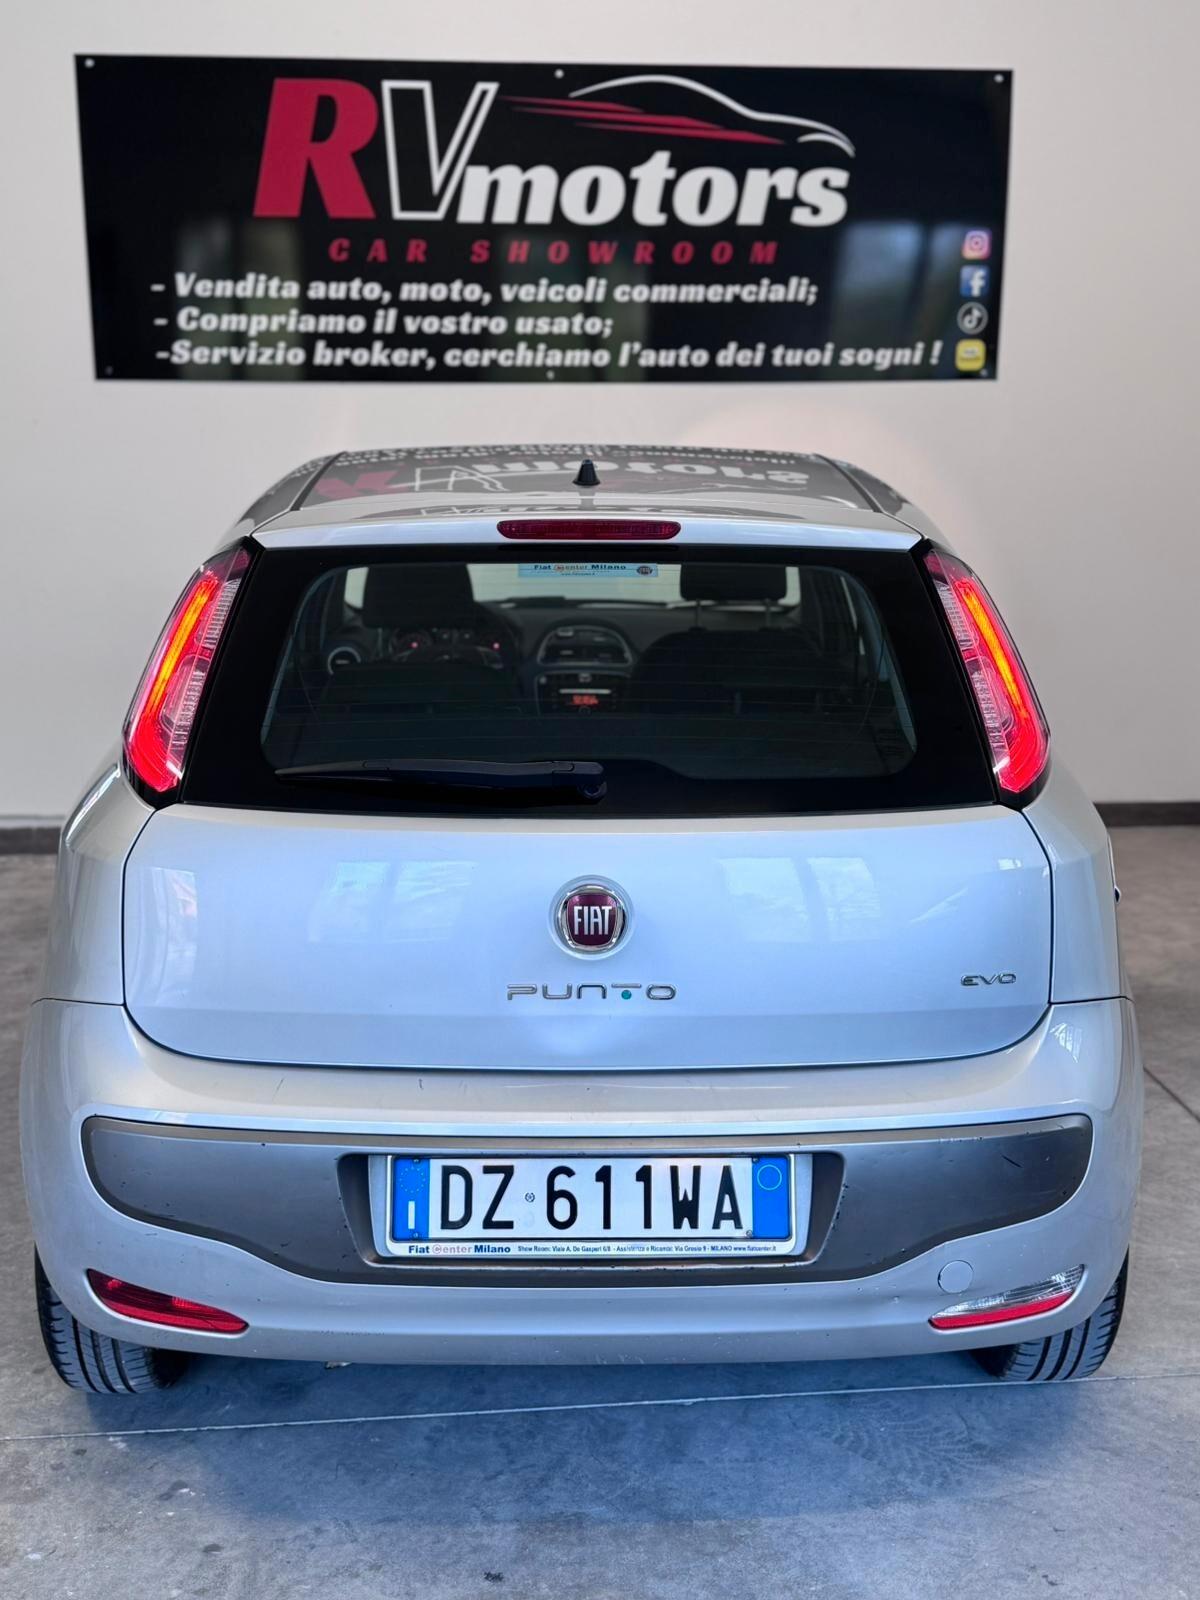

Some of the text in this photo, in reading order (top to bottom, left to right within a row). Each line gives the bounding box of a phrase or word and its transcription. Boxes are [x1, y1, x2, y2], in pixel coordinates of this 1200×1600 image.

[328, 238, 779, 265] CAR SHOWROOM
[174, 271, 299, 299] Vendita
[306, 277, 392, 305] auto,
[398, 278, 492, 305] moto,
[500, 277, 606, 303] veicoli
[613, 276, 818, 306] commerciali;
[177, 306, 366, 337] Compriamo
[373, 308, 397, 334] il
[403, 311, 508, 335] vostro
[515, 312, 613, 338] usato;
[313, 341, 436, 371] broker,
[443, 341, 610, 367] cerchiamo
[715, 342, 765, 367] dei
[771, 343, 833, 367] tuoi
[839, 341, 923, 371] sogni
[573, 905, 612, 935] FIAT
[506, 983, 677, 1001] PUNTO
[960, 972, 1016, 987] EVO
[440, 1164, 514, 1230] DZ
[408, 1245, 430, 1253] Fiat
[474, 1244, 511, 1253] Milano
